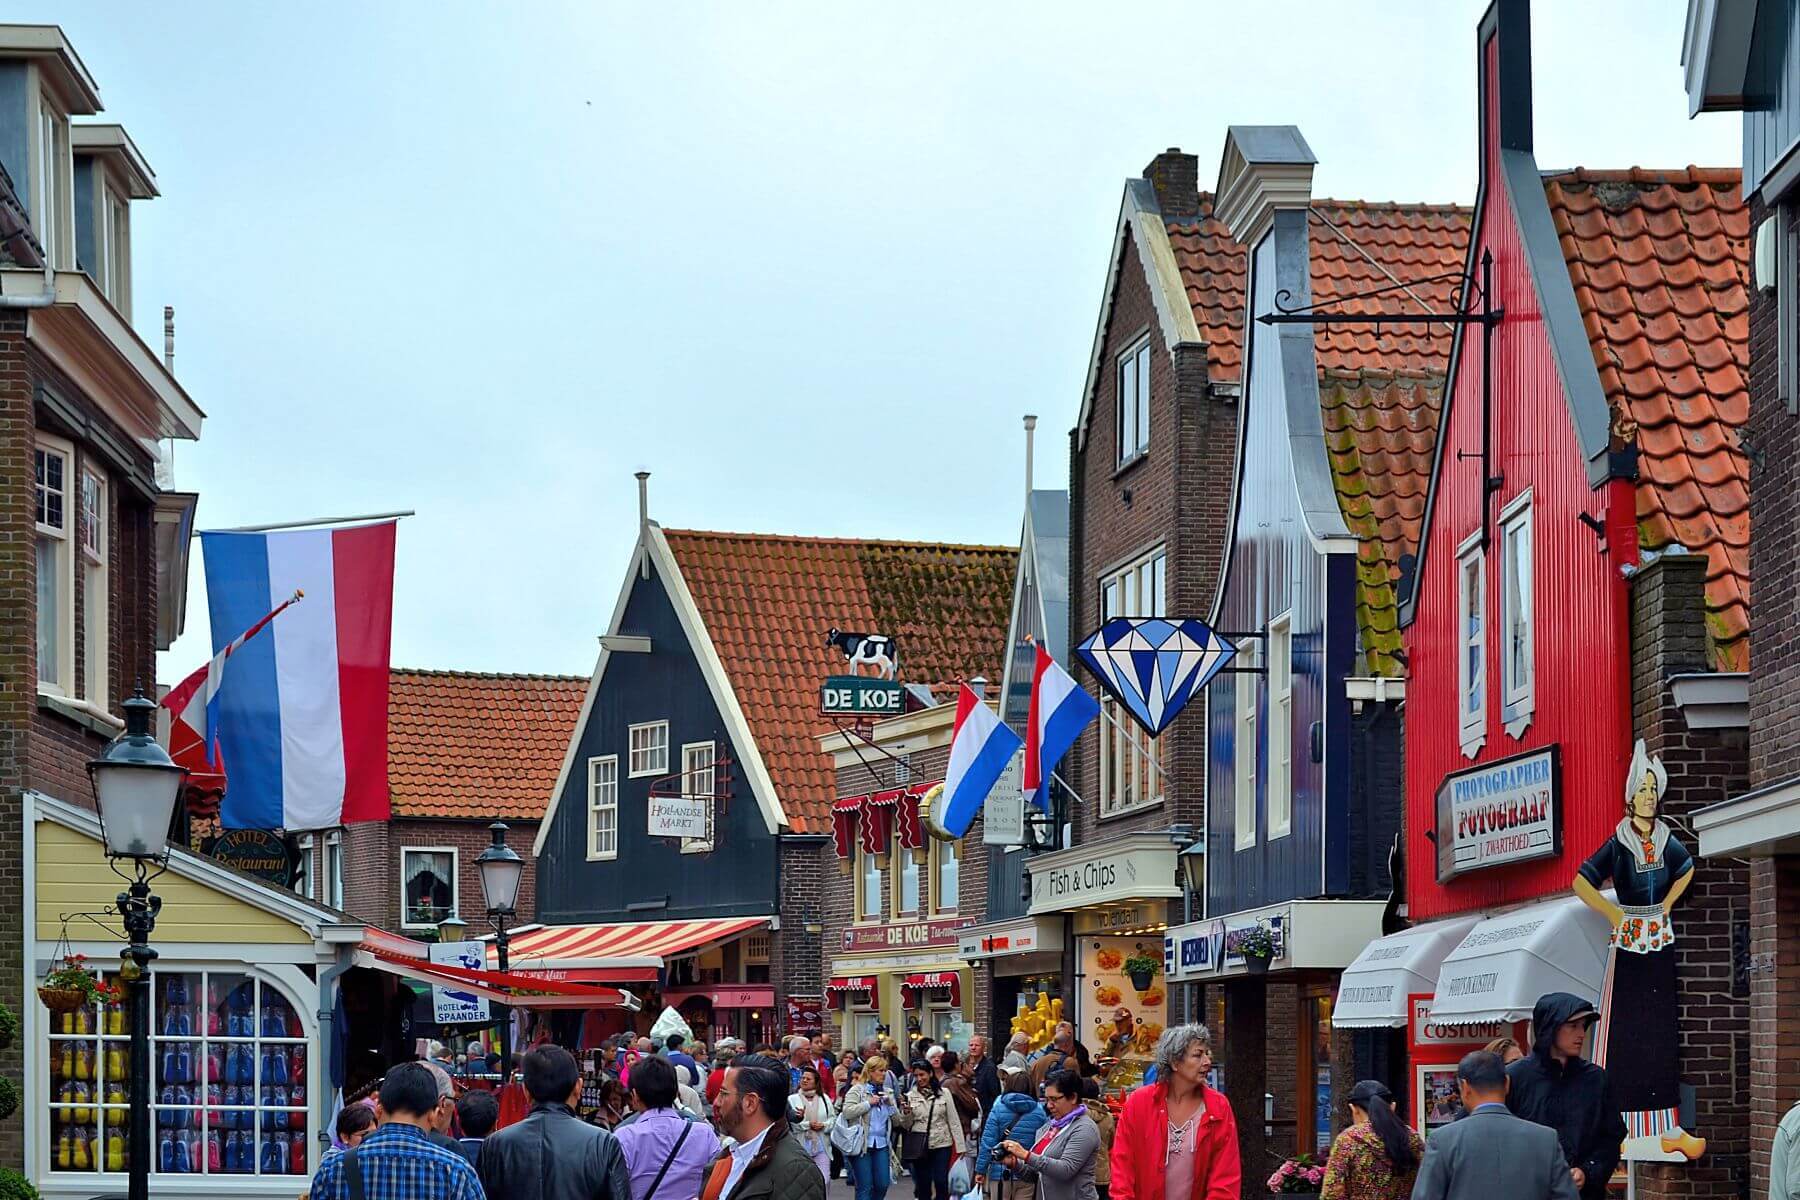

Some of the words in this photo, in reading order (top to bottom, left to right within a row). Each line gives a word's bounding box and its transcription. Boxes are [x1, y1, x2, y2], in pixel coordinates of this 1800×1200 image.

[823, 688, 852, 708] DE
[860, 689, 901, 708] KOE
[1455, 758, 1549, 803] PHOTOGRAPHER
[651, 805, 703, 816] HOLLANDSE
[1457, 789, 1550, 840] FOTOGRAAF
[660, 818, 693, 828] MARKT
[227, 831, 268, 848] HOTEL
[216, 853, 285, 871] Restaurant
[1050, 871, 1070, 896] Fish
[1073, 870, 1081, 892] &
[1084, 860, 1116, 890] Chips
[888, 927, 903, 945] DE
[905, 925, 928, 943] KOE
[438, 1003, 460, 1011] HOTEL
[438, 1012, 485, 1021] SPAANDER
[1424, 1023, 1501, 1039] COSTUME
